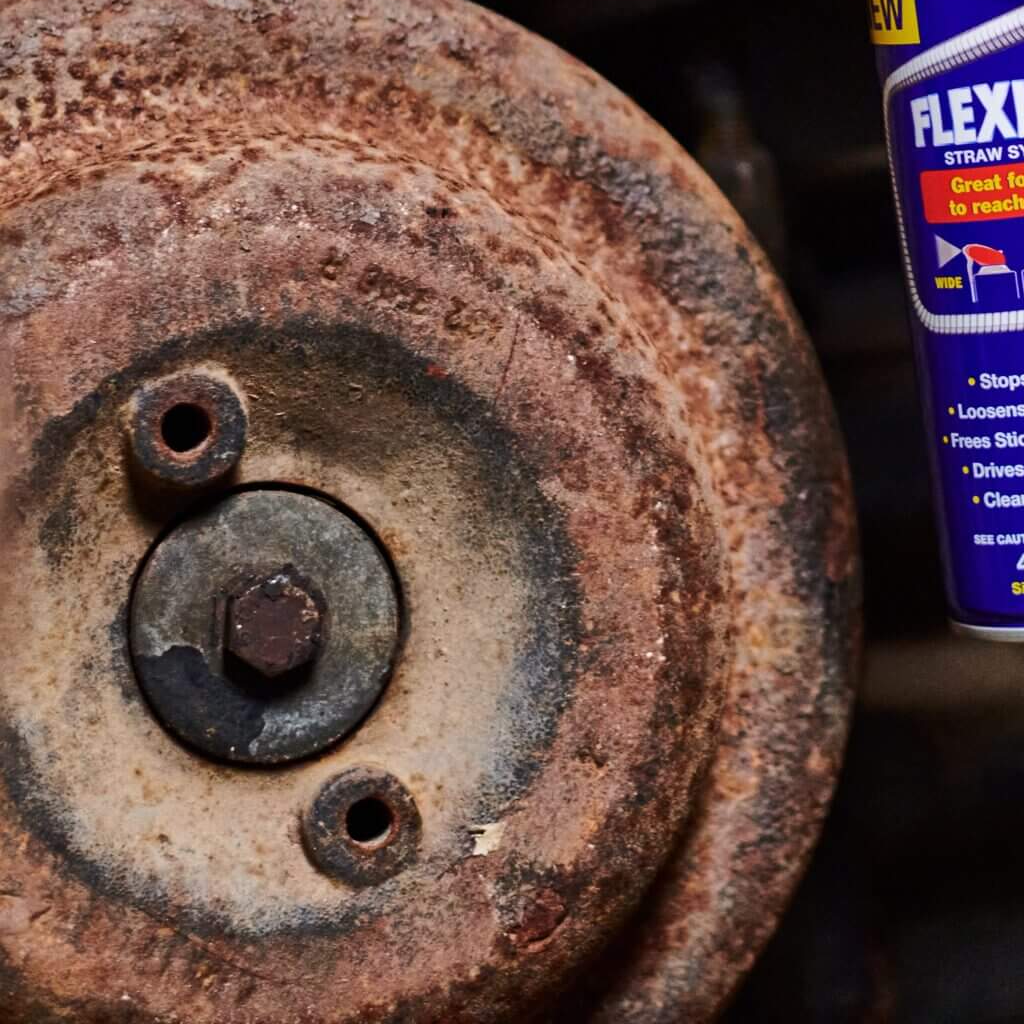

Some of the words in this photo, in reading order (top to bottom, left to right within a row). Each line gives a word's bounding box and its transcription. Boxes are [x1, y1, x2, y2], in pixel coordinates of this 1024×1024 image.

[944, 147, 1003, 165] STRAW
[951, 174, 1002, 194] Great
[949, 199, 967, 216] to
[934, 276, 963, 289] WIDE
[950, 432, 992, 449] Frees
[973, 533, 995, 545] SEE
